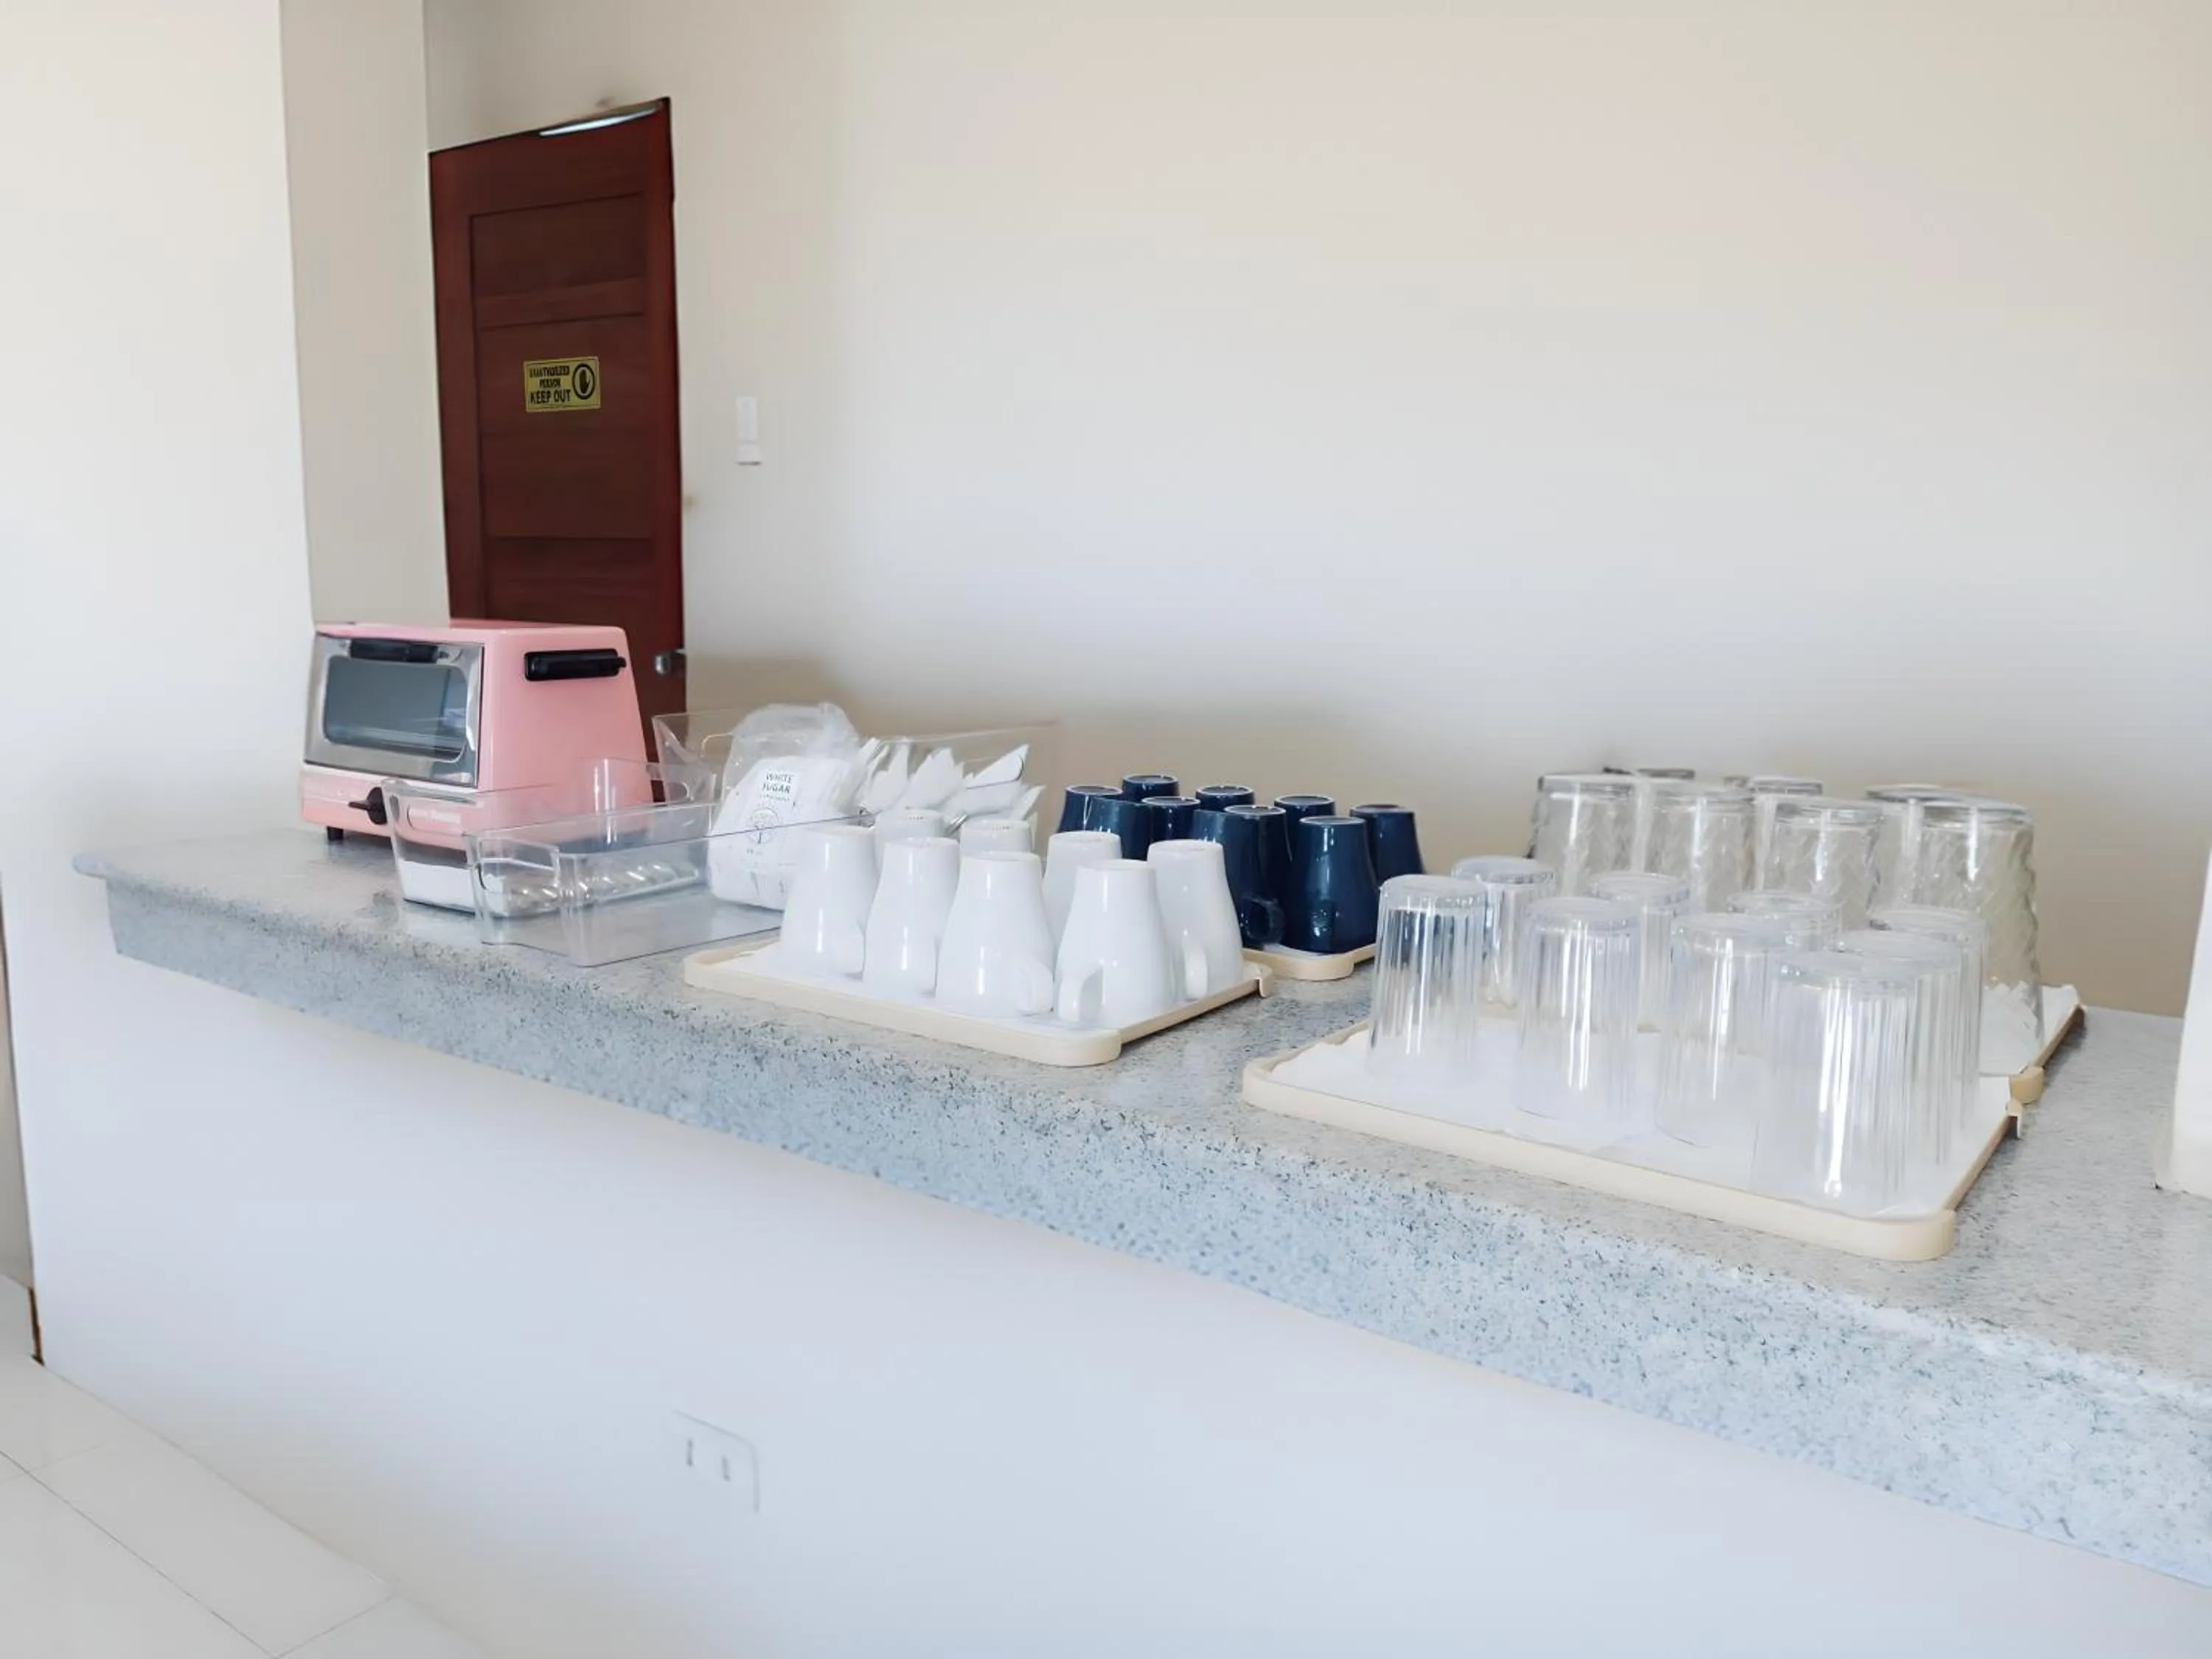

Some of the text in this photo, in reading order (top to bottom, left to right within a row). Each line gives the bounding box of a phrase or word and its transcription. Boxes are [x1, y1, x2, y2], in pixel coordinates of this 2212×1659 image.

[530, 389, 571, 404] KEEP OUT
[766, 773, 791, 783] WHITE
[762, 782, 791, 794] SUGAR
